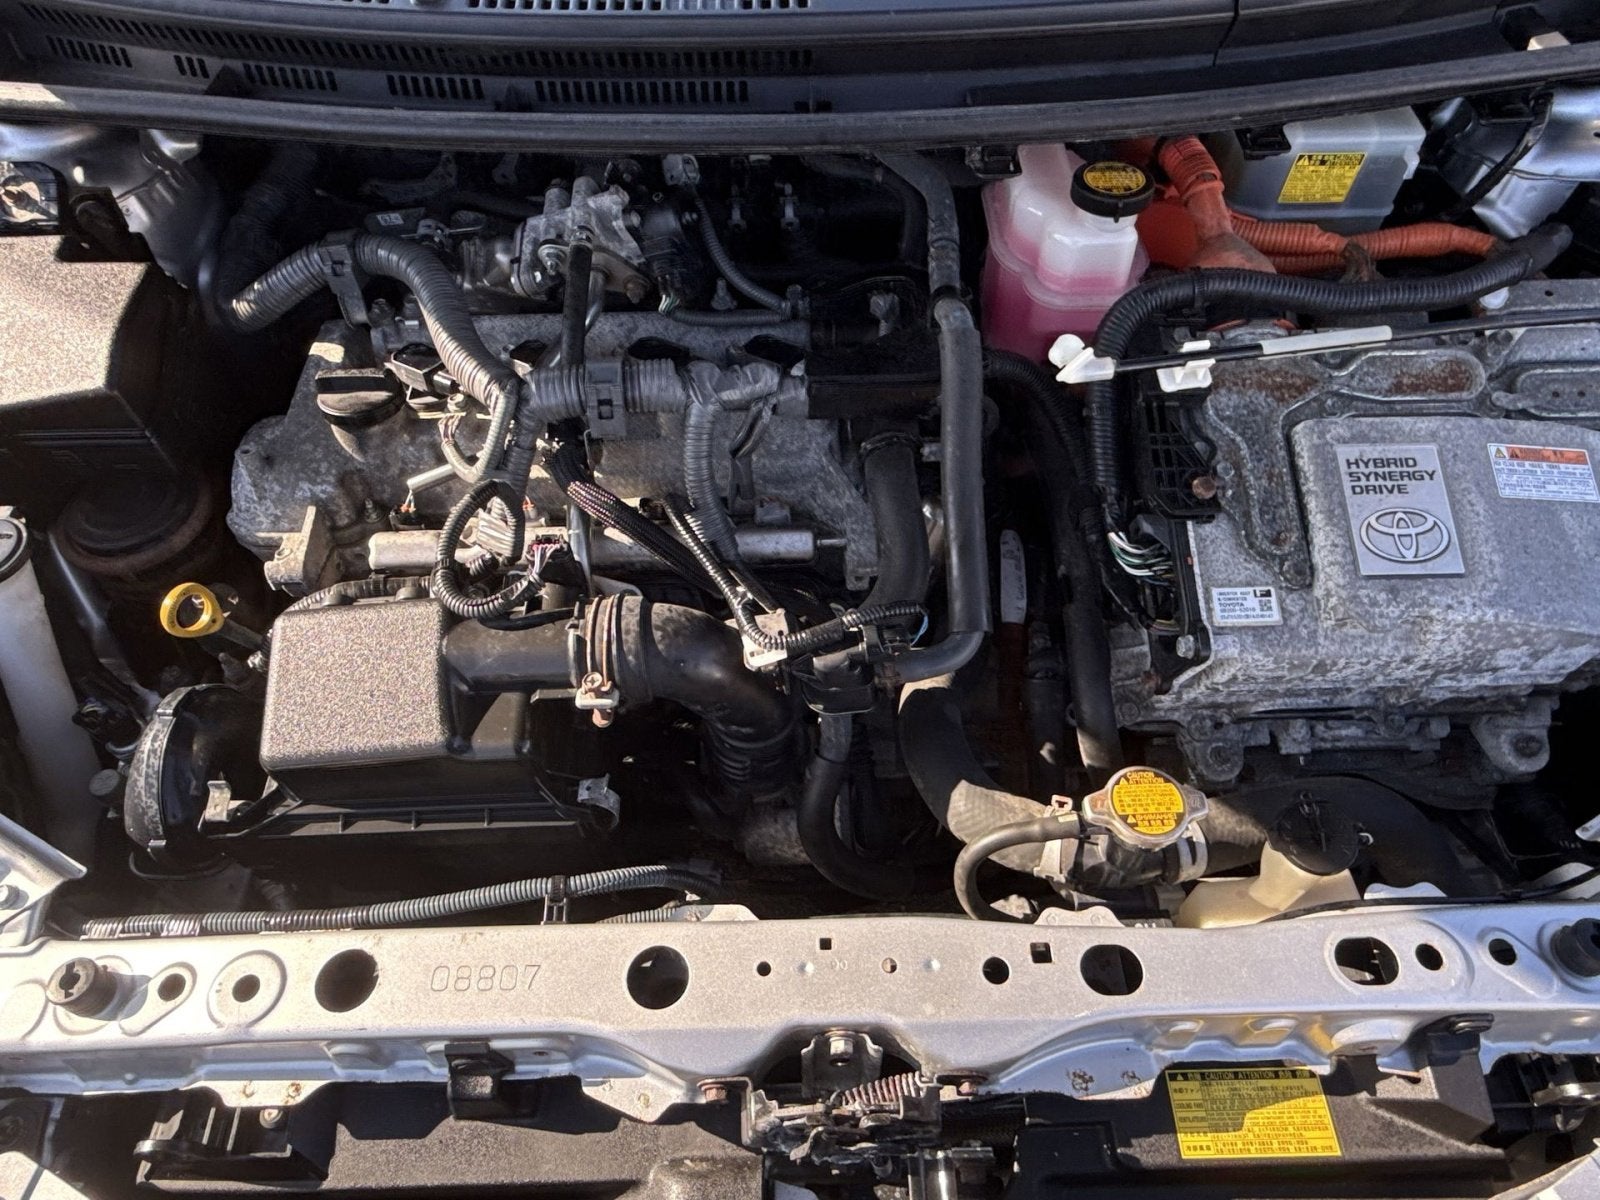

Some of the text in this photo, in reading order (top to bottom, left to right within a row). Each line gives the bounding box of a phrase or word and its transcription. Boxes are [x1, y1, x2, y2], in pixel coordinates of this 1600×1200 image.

[1345, 457, 1418, 470] HYBRID
[1348, 470, 1437, 482] SYNERGY
[1351, 484, 1409, 495] DRIVE
[1126, 771, 1155, 779] CAUTION
[430, 964, 541, 992] 08807
[1204, 1071, 1235, 1080] CAUTION
[1238, 1070, 1275, 1080] ATTENTION
